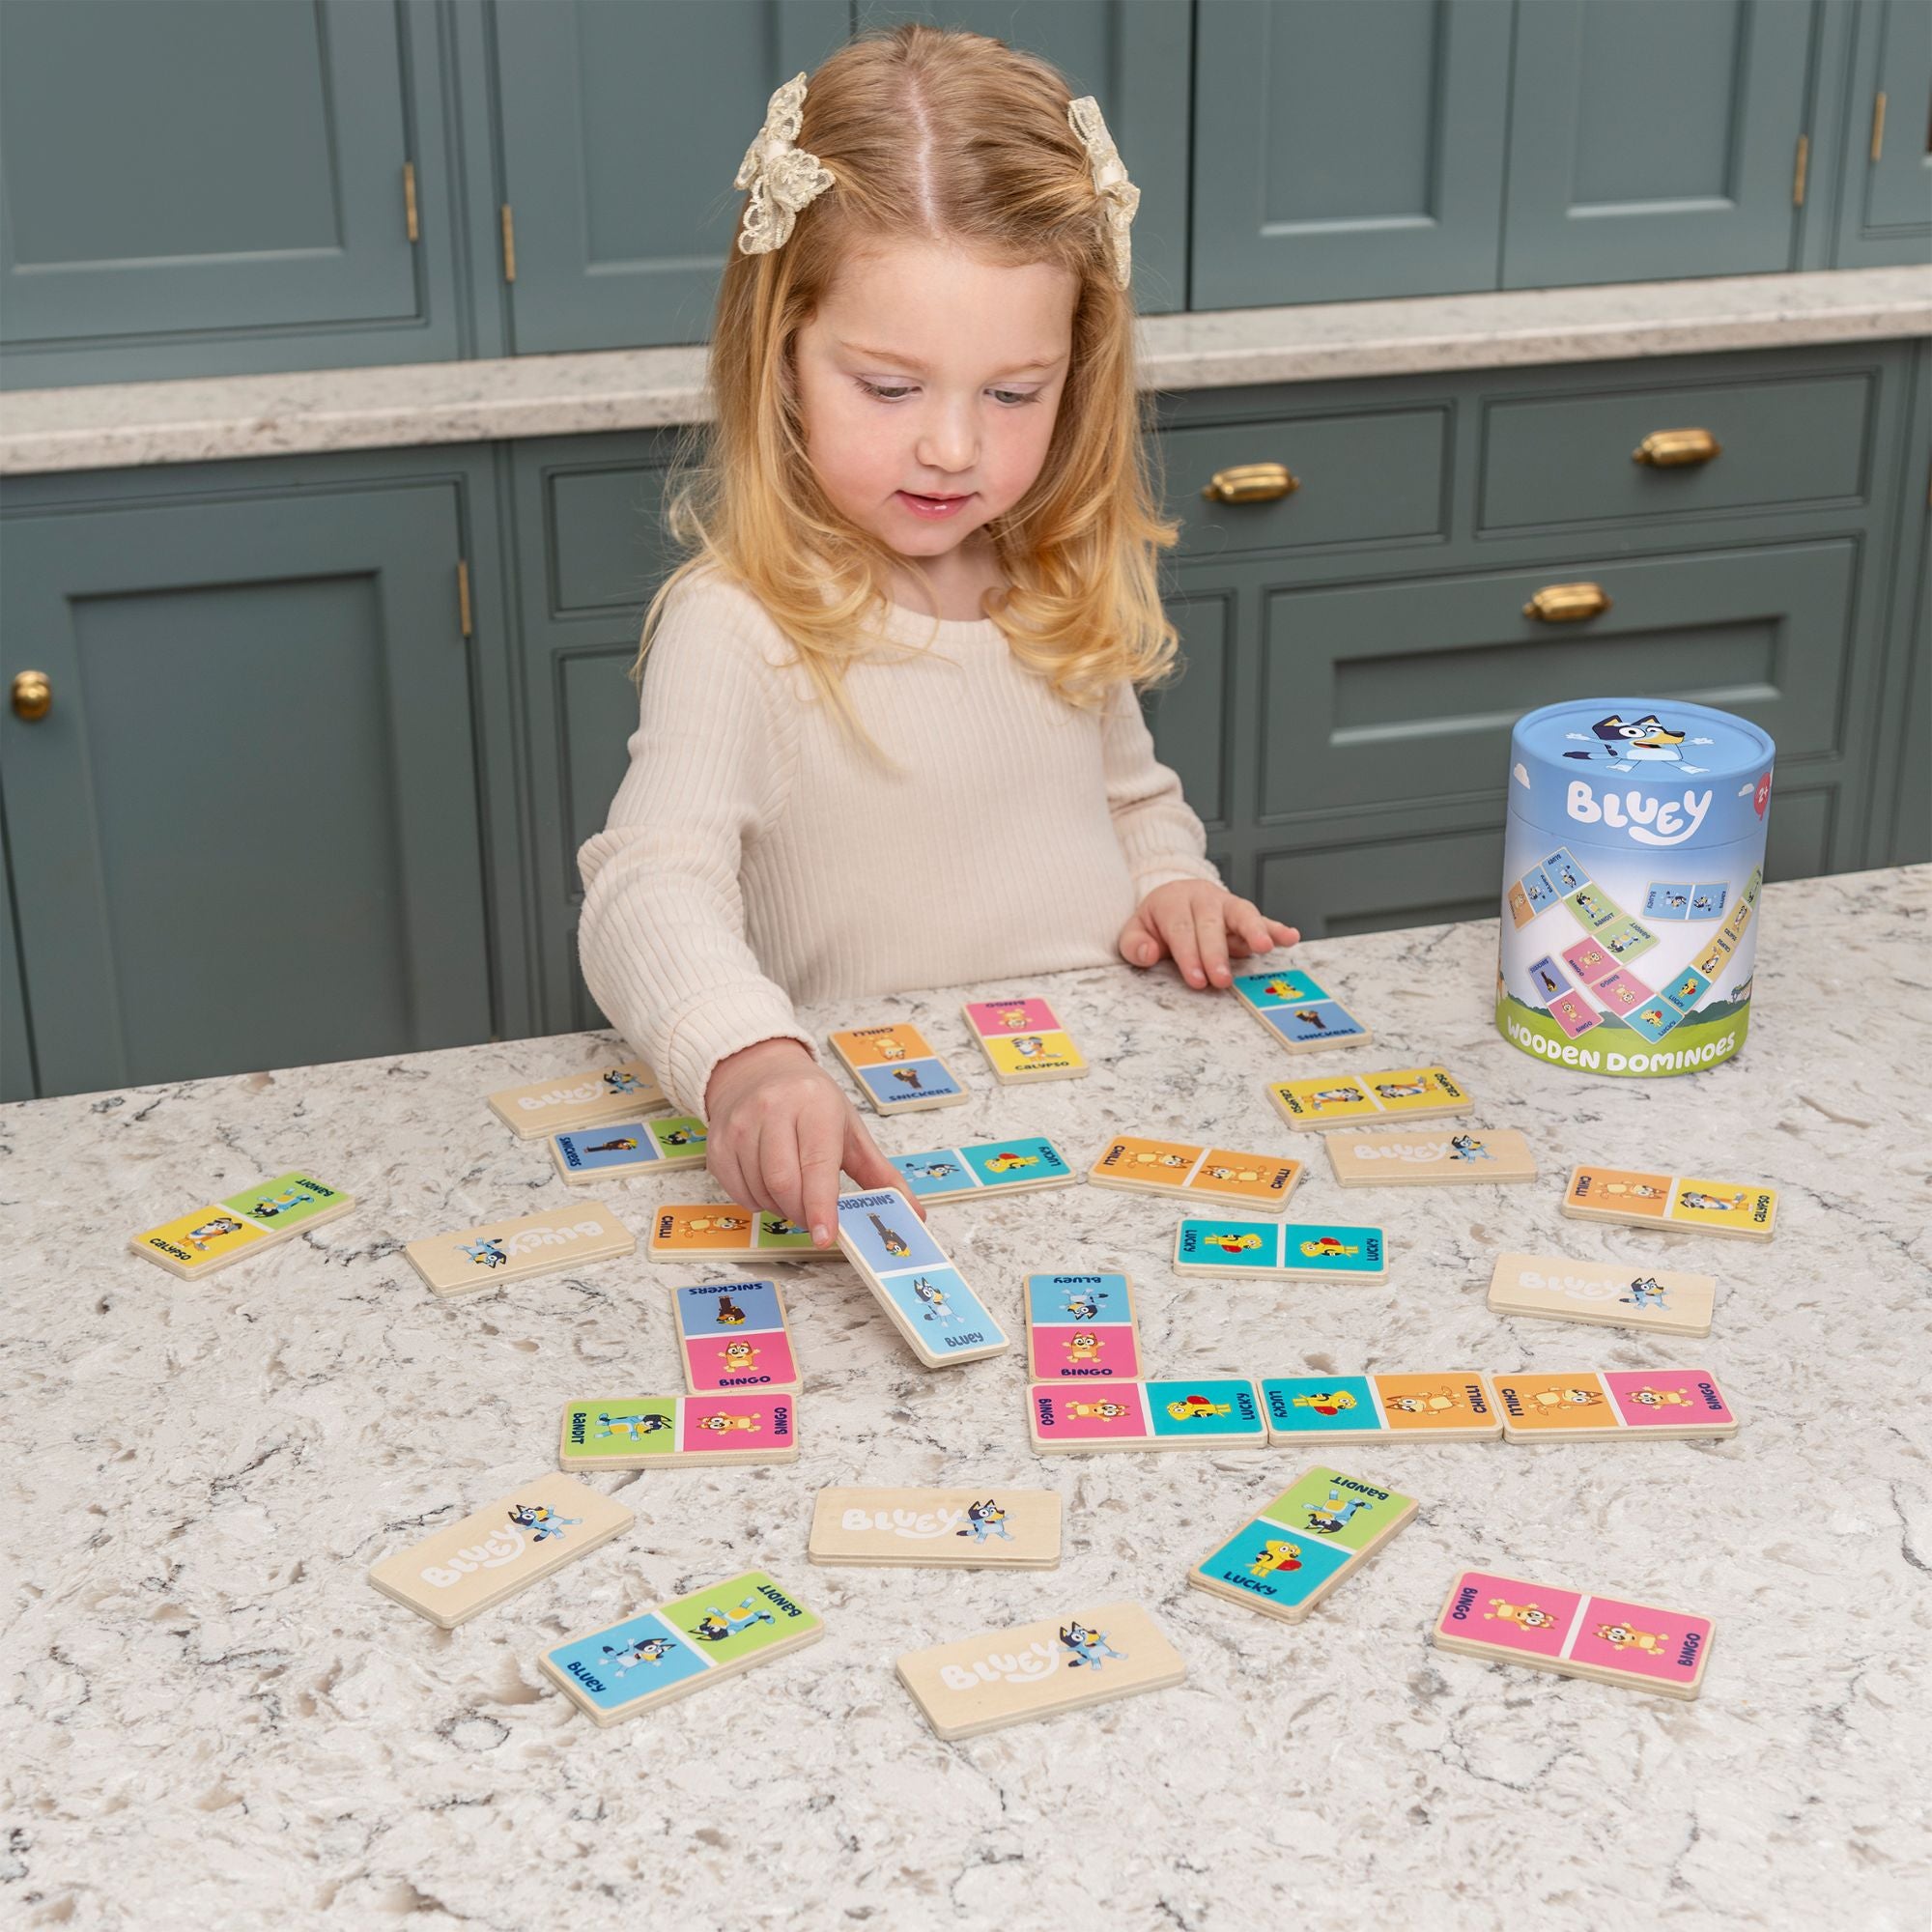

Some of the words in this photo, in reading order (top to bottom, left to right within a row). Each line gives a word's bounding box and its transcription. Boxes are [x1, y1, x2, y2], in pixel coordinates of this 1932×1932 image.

[1567, 780, 1714, 846] BLUEY
[1646, 891, 1657, 909] BLUEY
[1569, 959, 1585, 978] BINGO
[985, 999, 1026, 1009] BINGO
[853, 1027, 895, 1037] CHILLI
[518, 1081, 604, 1110] BLUEY
[1037, 1146, 1061, 1167] LUCKY
[1103, 1145, 1125, 1166] CHILLI
[1353, 1142, 1448, 1163] BLUEY
[1270, 1168, 1292, 1189] CHILLI
[1576, 1176, 1592, 1197] CHILLI
[507, 1220, 605, 1256] BLUEY
[659, 1215, 674, 1238] CHILLI
[1183, 1230, 1197, 1253] LUCKY
[1367, 1238, 1379, 1262] LUCKY
[1520, 1271, 1626, 1301] BLUEY
[719, 1375, 772, 1387] BINGO
[1061, 1368, 1113, 1377] BINGO
[1236, 1392, 1256, 1421] LUCKY
[1268, 1390, 1289, 1418] LUCKY
[1465, 1385, 1488, 1414] CHILLI
[1501, 1388, 1524, 1417] CHILLI
[1697, 1382, 1722, 1410] BINGO
[774, 1406, 788, 1435] BINGO
[1038, 1398, 1055, 1426] BINGO
[841, 1508, 963, 1540] BLUEY
[419, 1523, 526, 1589] BLUEY
[1223, 1571, 1278, 1596] LUCKY
[1452, 1586, 1479, 1621] BINGO
[1677, 1633, 1701, 1667] BINGO
[939, 1639, 1062, 1690] BLUEY
